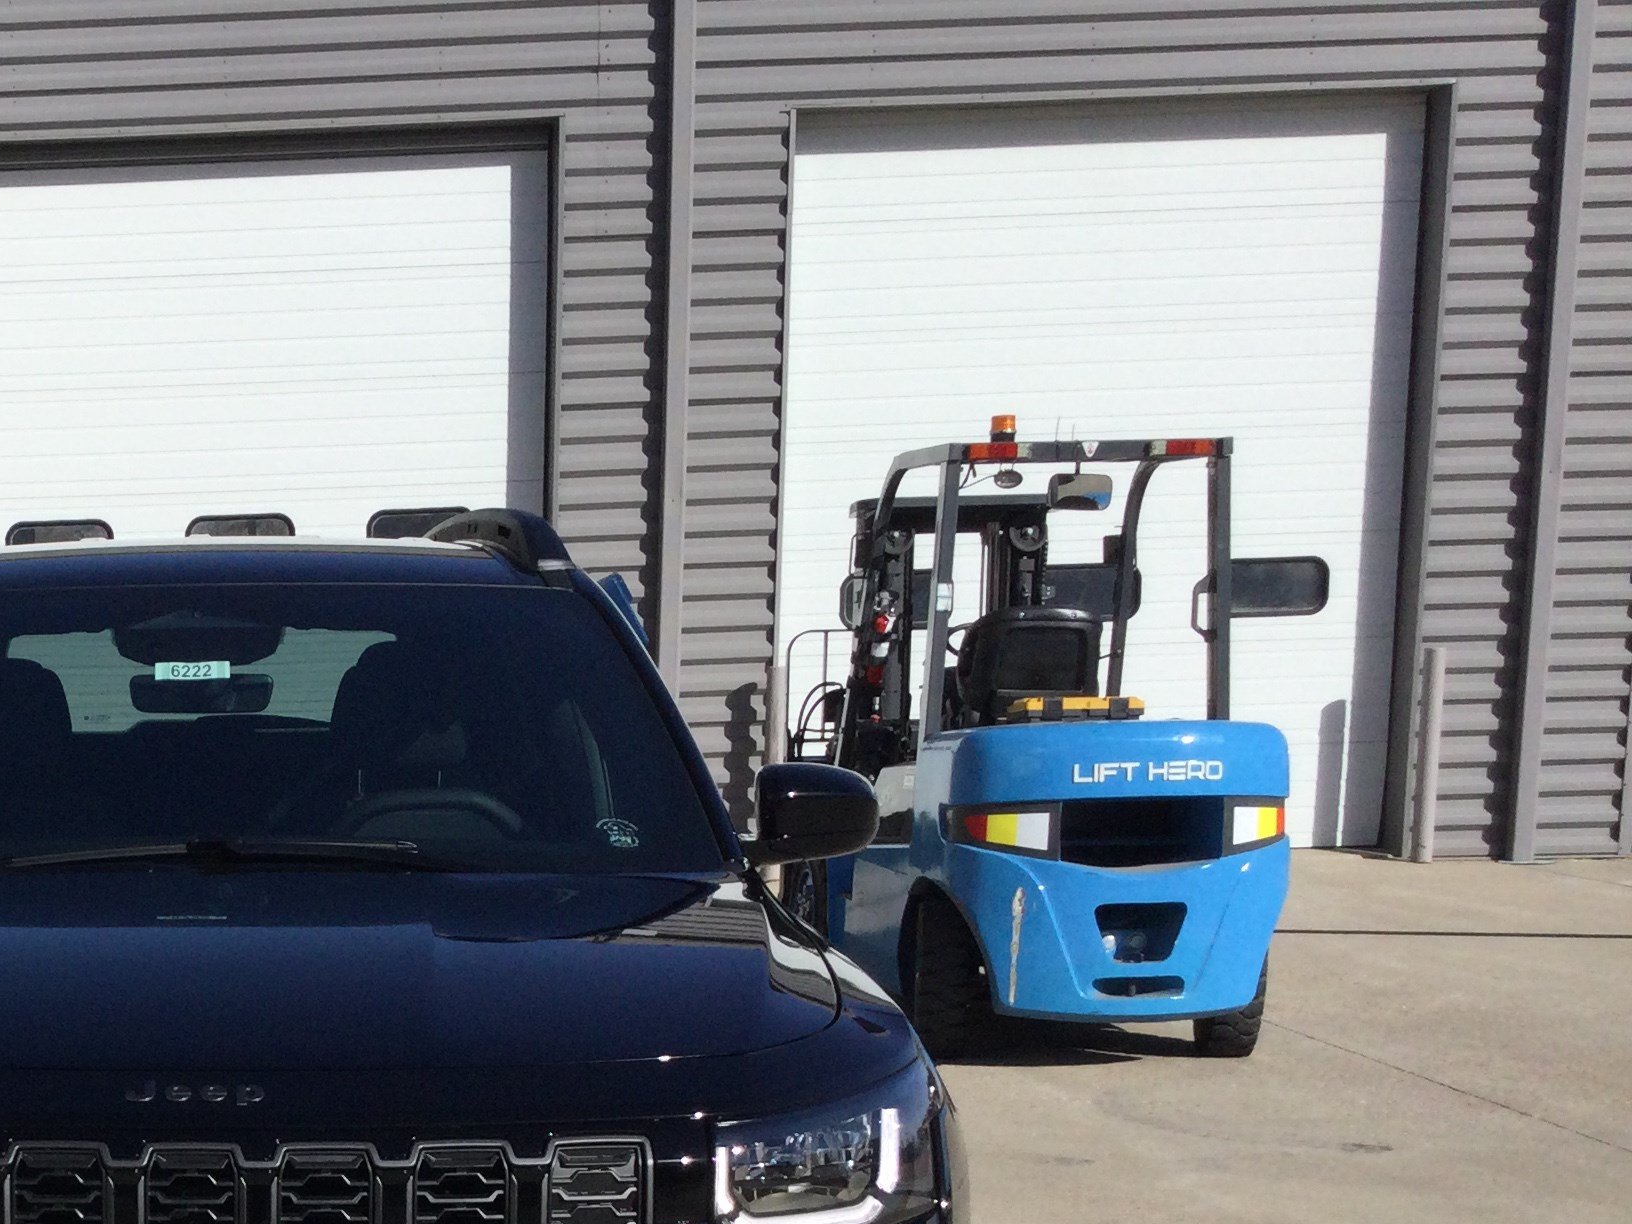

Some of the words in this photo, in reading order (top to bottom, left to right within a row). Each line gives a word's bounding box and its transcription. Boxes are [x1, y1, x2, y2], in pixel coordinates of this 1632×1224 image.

[170, 663, 213, 679] 6222
[1072, 761, 1141, 784] LIFT
[1147, 759, 1223, 782] HERO
